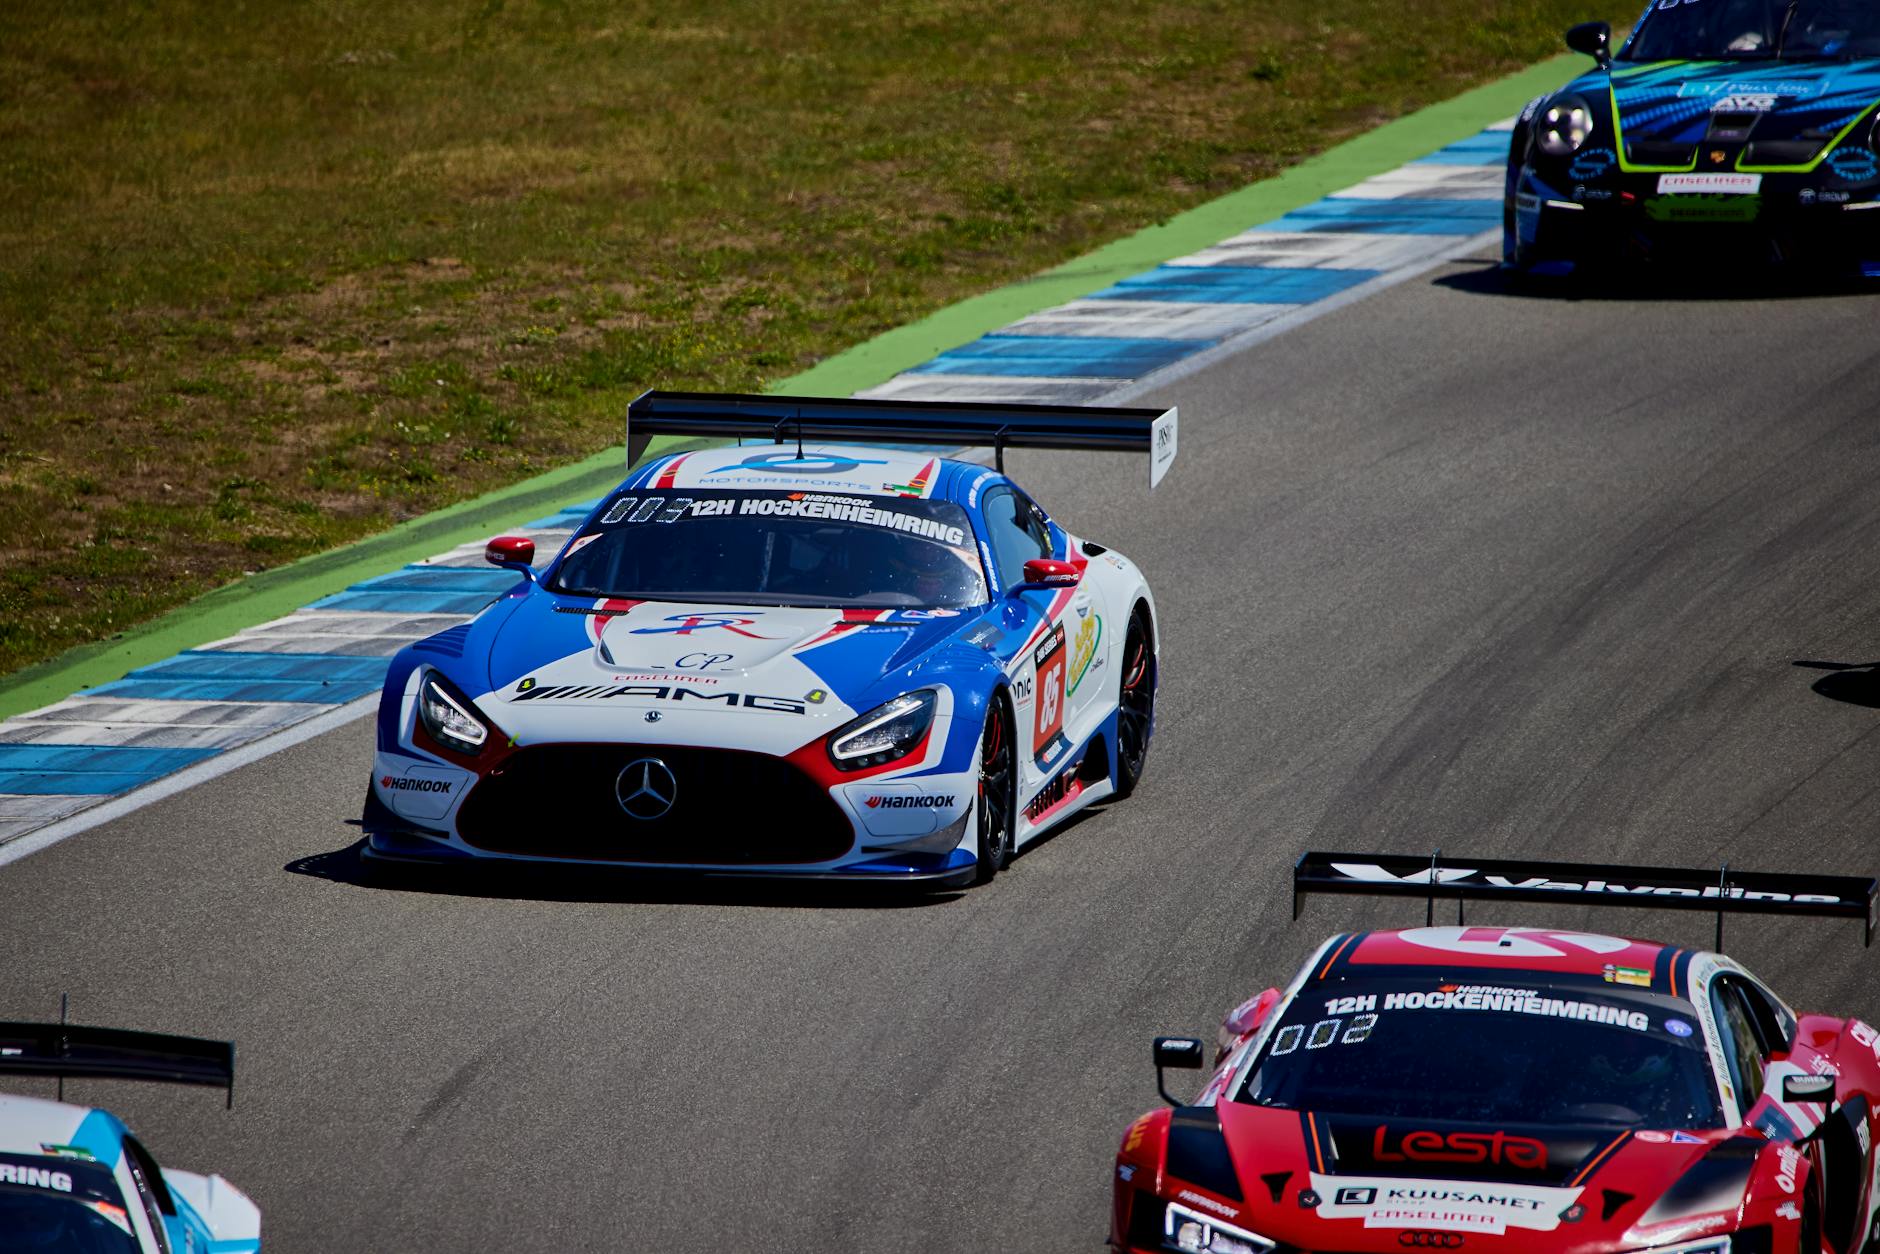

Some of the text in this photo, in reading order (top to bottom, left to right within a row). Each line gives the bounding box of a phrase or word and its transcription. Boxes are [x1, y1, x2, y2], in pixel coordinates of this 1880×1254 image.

[699, 477, 871, 490] MOTORSPORTS
[690, 499, 964, 546] 12H HOCKENHEIMRING
[675, 652, 735, 670] CP
[598, 686, 806, 715] AMG
[1040, 661, 1061, 734] 85
[1325, 992, 1649, 1032] 12H HOCKENHEIMRING
[1373, 1124, 1548, 1170] Lesta
[1387, 1189, 1546, 1211] KUUSAMET
